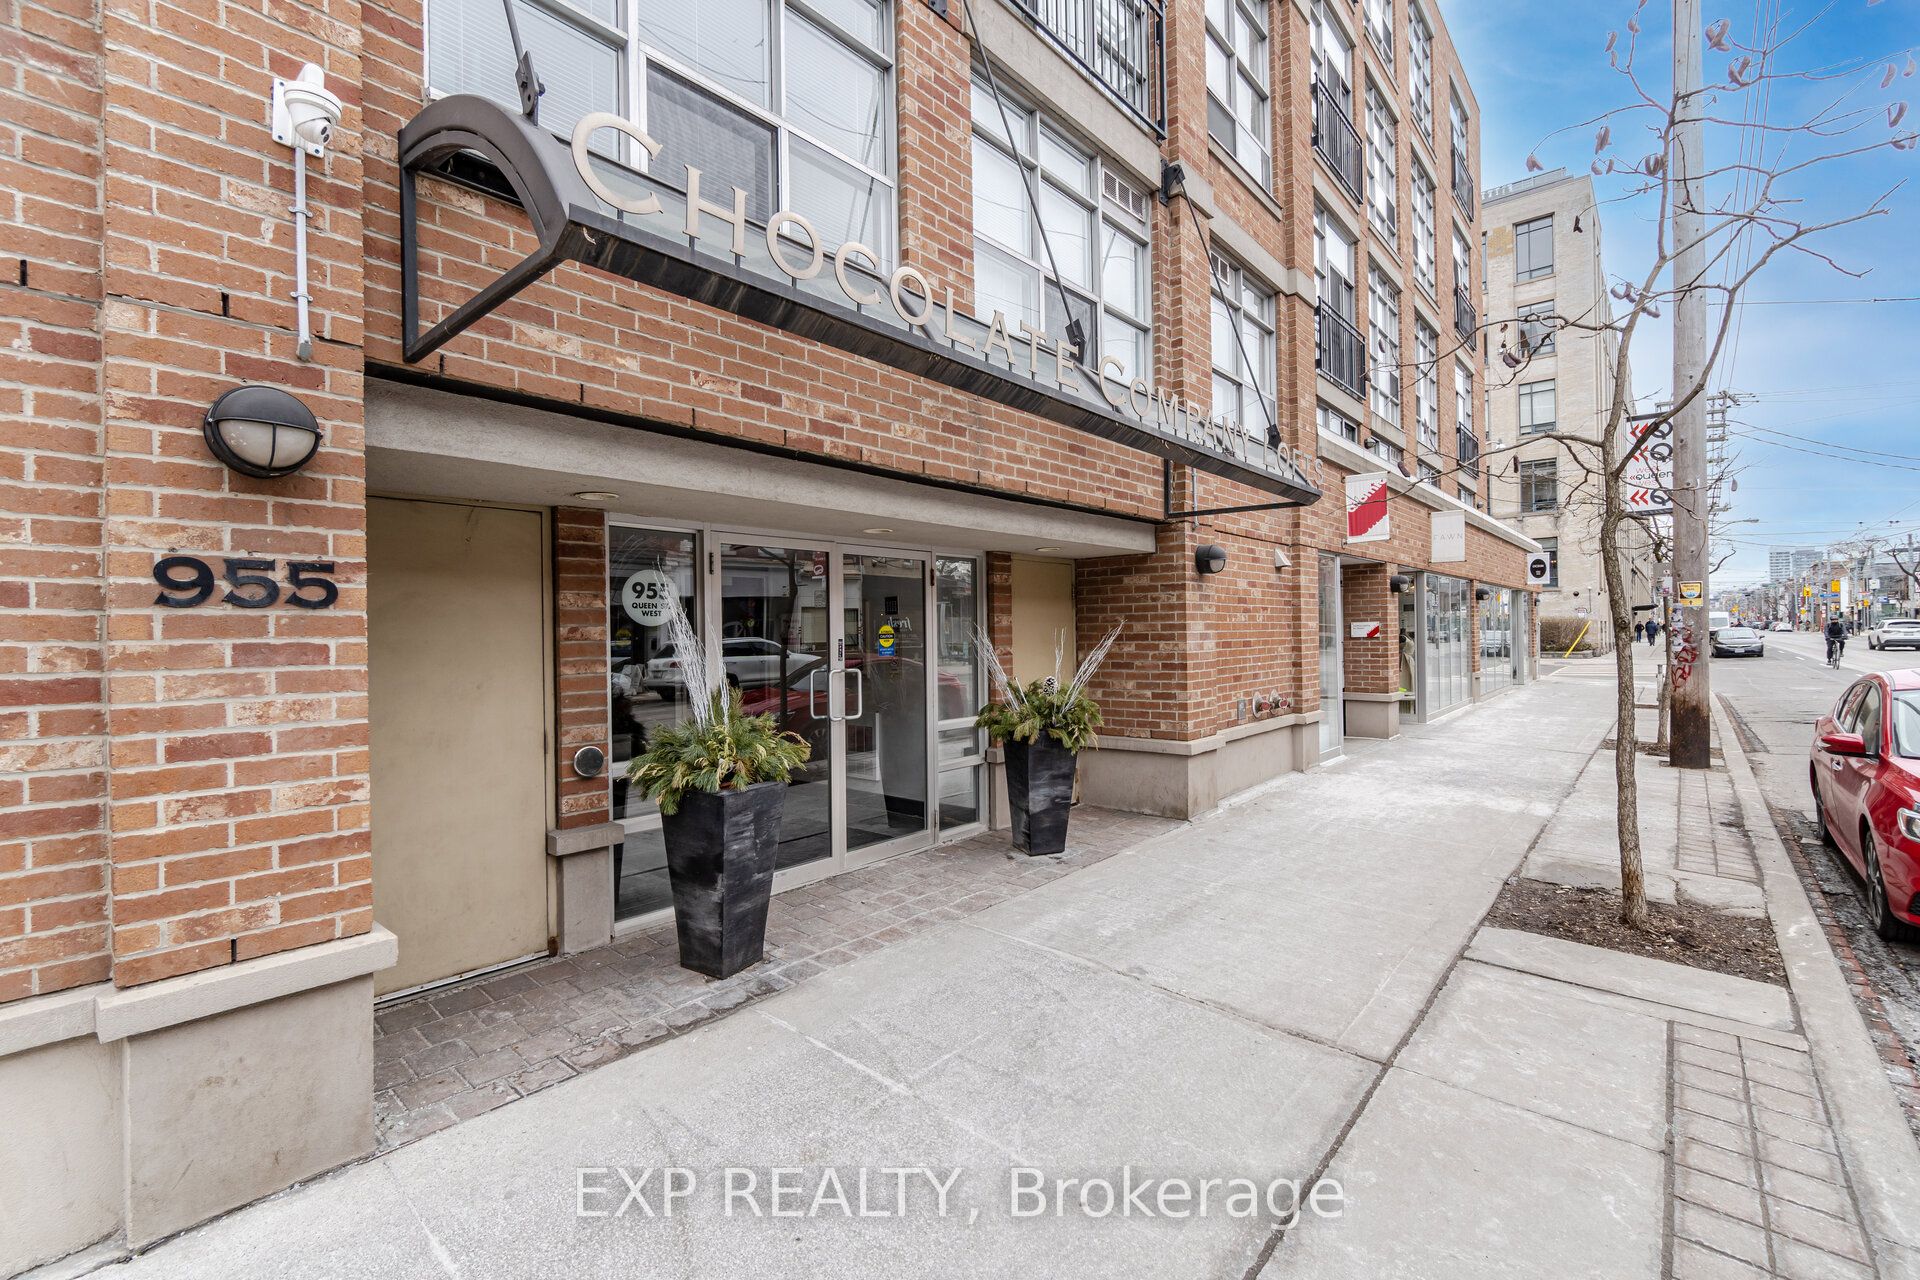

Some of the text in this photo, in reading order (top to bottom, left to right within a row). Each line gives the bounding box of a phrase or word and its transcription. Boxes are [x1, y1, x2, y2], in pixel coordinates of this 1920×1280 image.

[571, 112, 1325, 486] CHOCOLATE COMPANY LOFTS
[153, 556, 339, 609] 955
[631, 602, 658, 610] QUEEN
